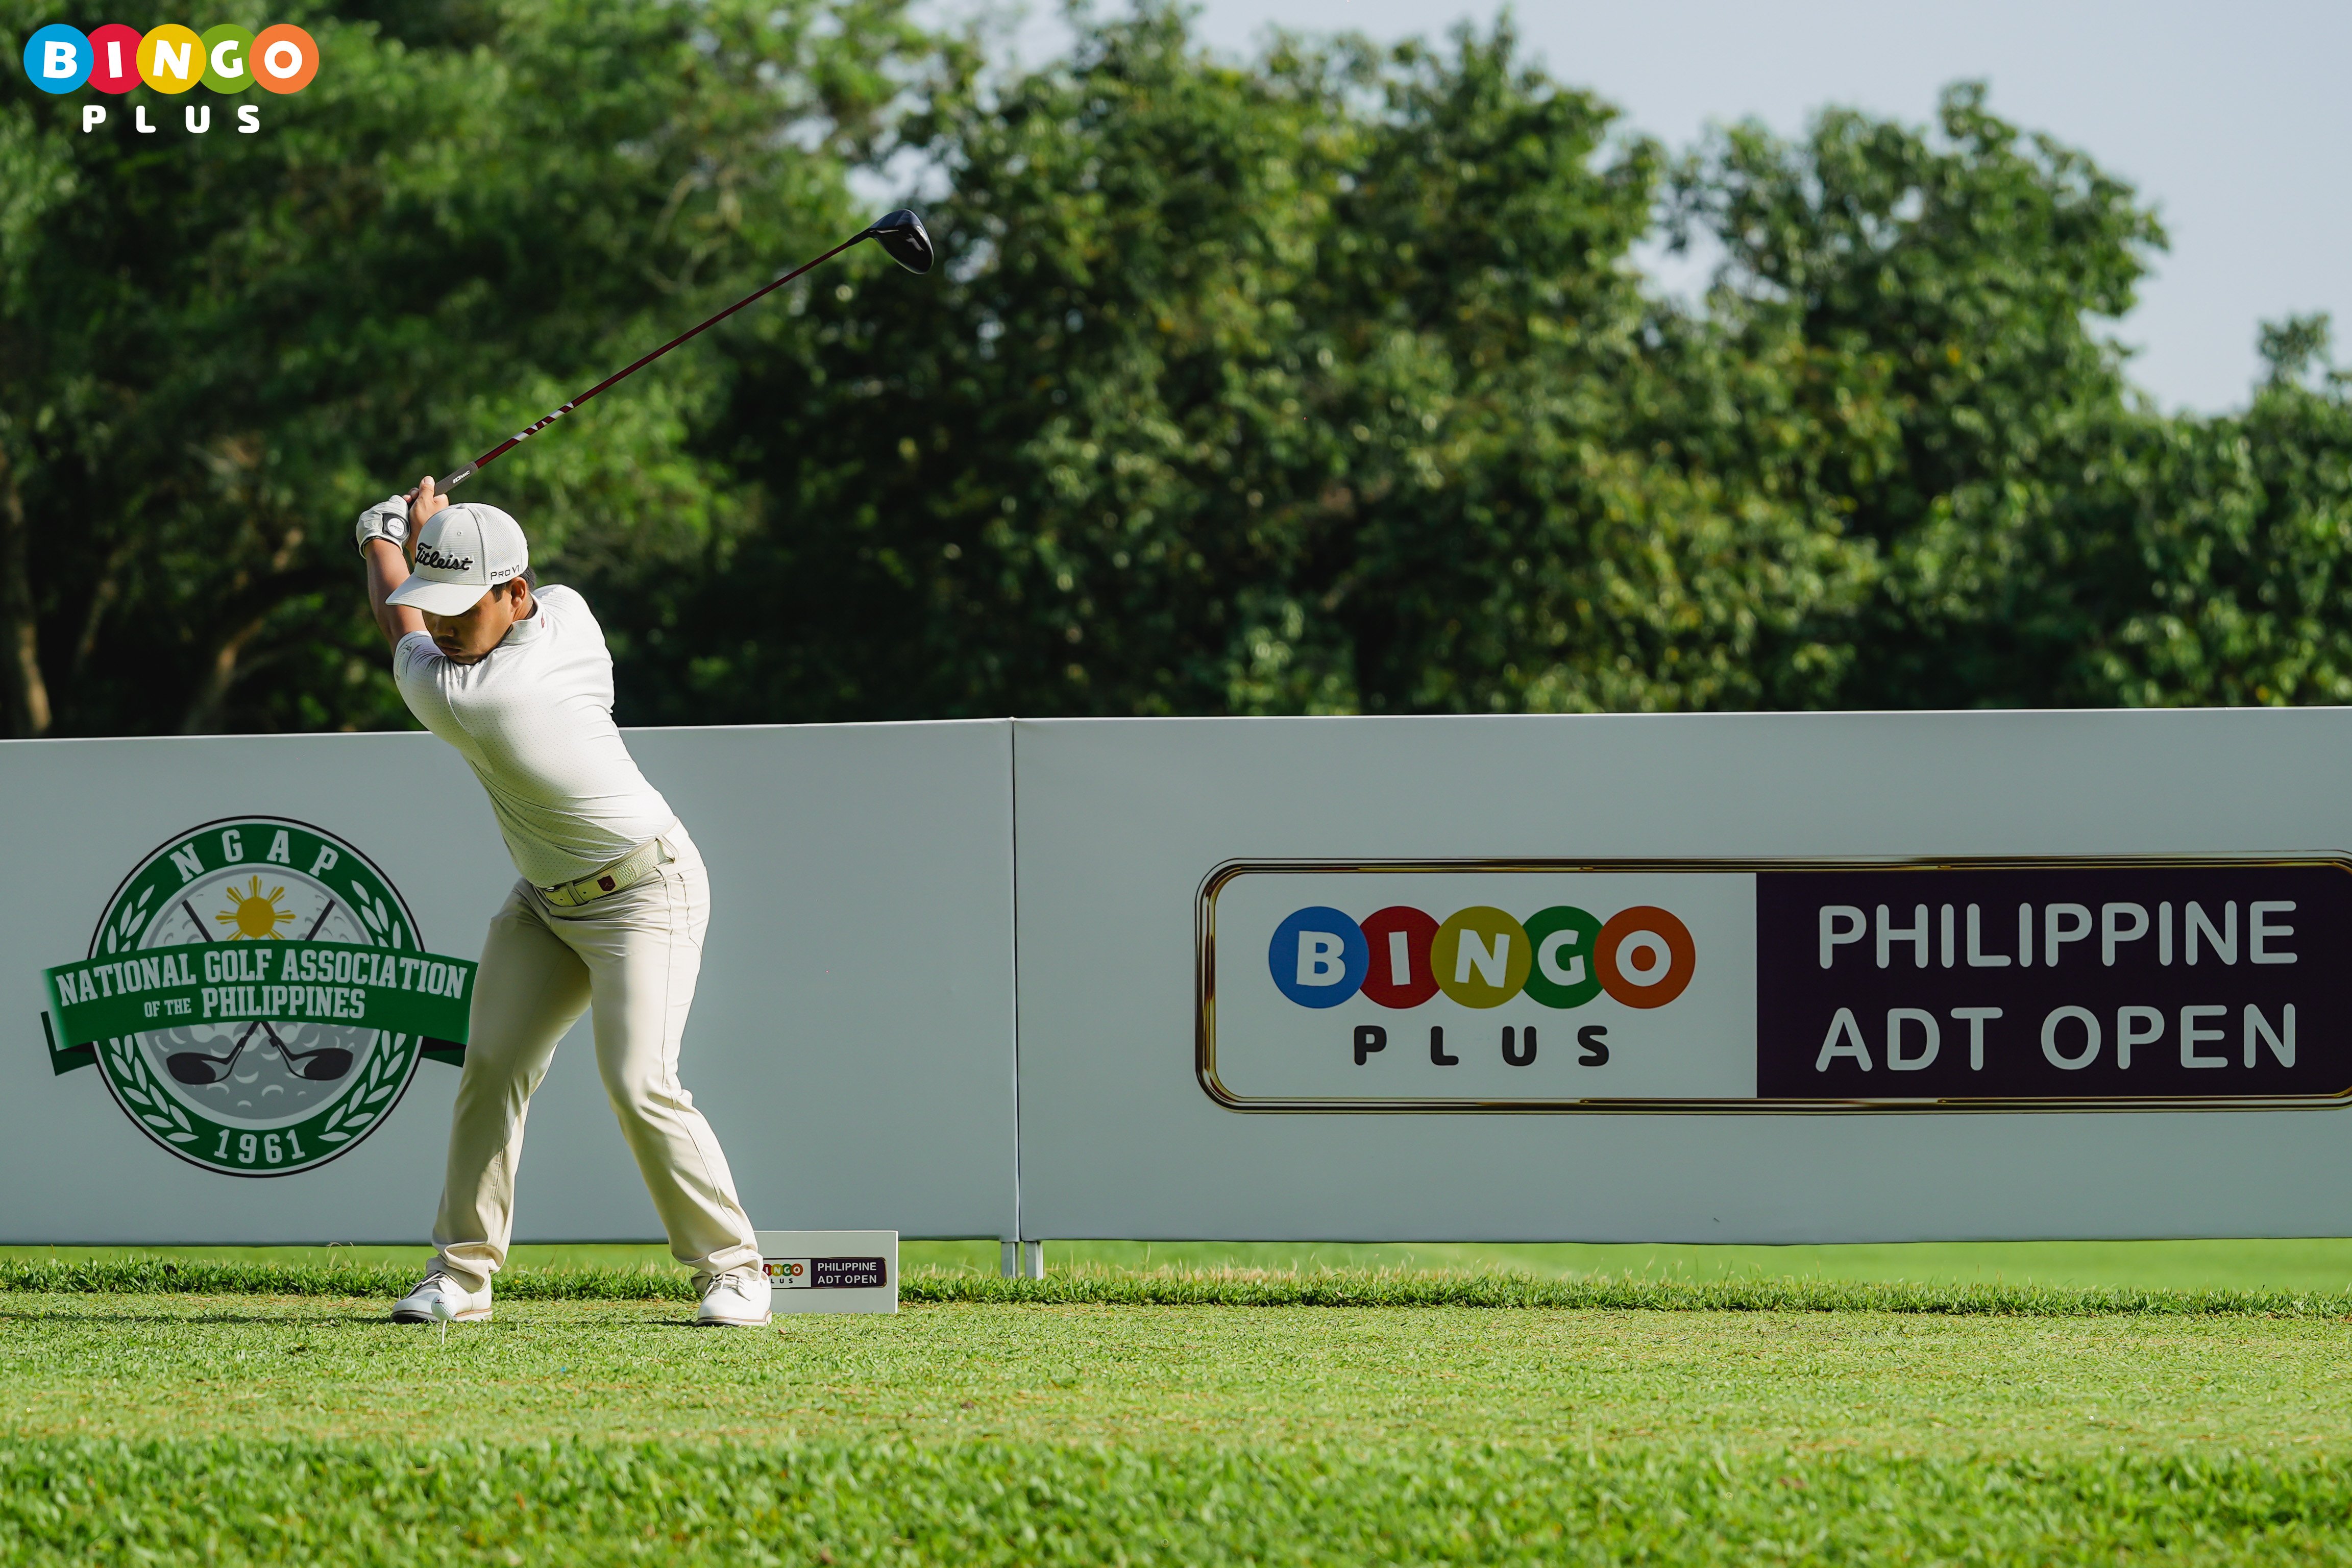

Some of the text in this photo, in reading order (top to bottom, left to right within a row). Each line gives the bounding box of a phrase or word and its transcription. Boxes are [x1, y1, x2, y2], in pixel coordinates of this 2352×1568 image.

[415, 542, 474, 571] Titleist
[490, 570, 510, 580] PRO
[170, 829, 340, 884] NGAP
[1819, 900, 2298, 969] PHILIPPINE
[1296, 928, 1672, 988] BINGO
[56, 948, 468, 1007] NATIONAL GOLF ASSOCIATION
[144, 985, 365, 1020] OF THE PHILIPPINES
[1354, 1025, 1610, 1067] PLUS
[1815, 1003, 2296, 1072] ADT OPEN
[214, 1129, 306, 1164] 1961
[818, 1262, 877, 1271] PHILIPPINE
[818, 1275, 877, 1284] ADT OPEN
